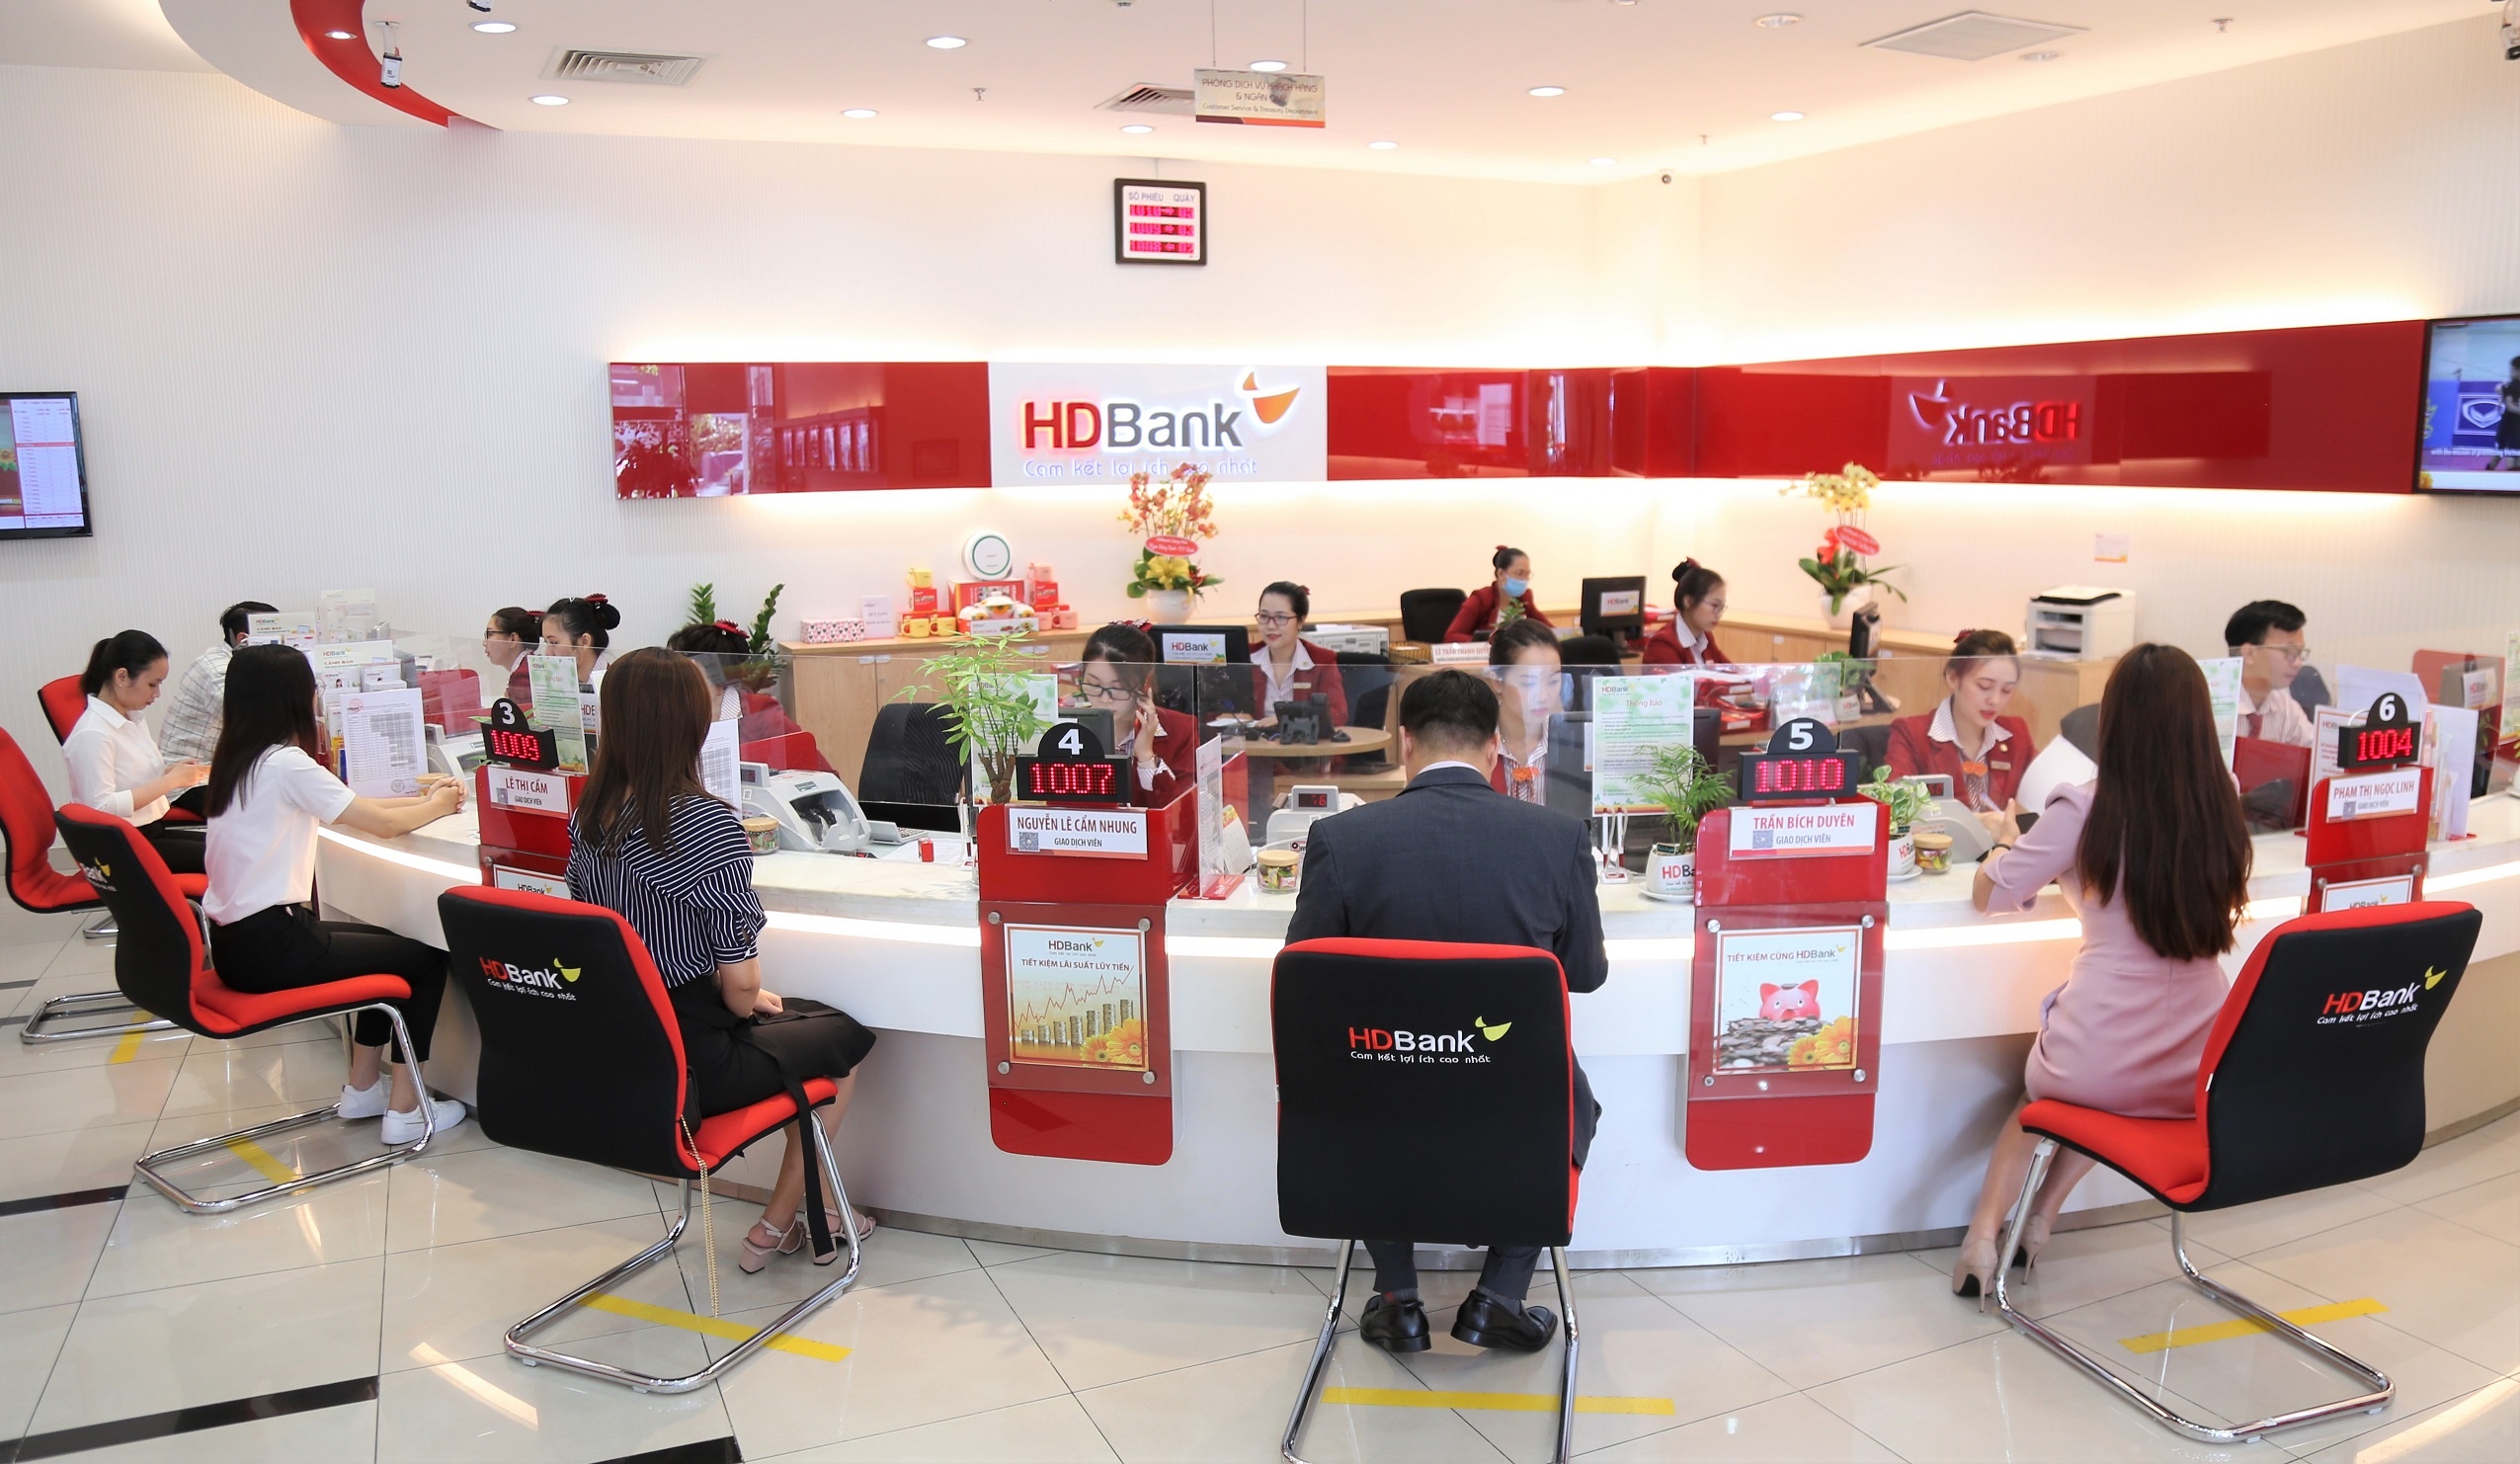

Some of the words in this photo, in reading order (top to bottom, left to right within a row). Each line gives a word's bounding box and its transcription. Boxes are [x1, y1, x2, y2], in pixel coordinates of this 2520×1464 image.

[1024, 401, 1243, 448] HDBank
[1172, 642, 1208, 651] HDBank
[499, 701, 516, 725] 3
[2379, 694, 2397, 722] 6
[491, 729, 540, 762] 1009
[1058, 728, 1083, 755] 4
[1789, 722, 1814, 750] 5
[2357, 727, 2413, 762] 1004
[505, 776, 515, 789] LÊ
[517, 778, 529, 794] THỊ
[1030, 763, 1113, 794] 1007
[1755, 758, 1843, 793] 1010
[2333, 785, 2358, 802] PHẠM
[2359, 784, 2373, 799] THỊ
[2374, 783, 2396, 798] NGỌC
[2397, 780, 2415, 792] LINH
[1016, 813, 1057, 832] NGUYỄN
[1061, 816, 1072, 832] LÊ
[1099, 819, 1137, 835] NHUNG
[1787, 812, 1814, 829] BÍCH
[1817, 812, 1855, 828] DUYÊN
[1054, 837, 1070, 847] GIAO
[1071, 838, 1086, 849] DỊCH
[1087, 838, 1102, 848] VIÊN
[1776, 836, 1794, 845] GIAO
[1795, 836, 1813, 847] DỊCH
[1814, 834, 1831, 844] VIÊN
[1048, 939, 1093, 952] HDBank
[1727, 951, 1746, 962] TIẾT
[1747, 951, 1768, 963] KIỆM
[1770, 950, 1795, 960] CÙNG
[1796, 948, 1836, 959] HDBank
[478, 956, 562, 990] HDBank
[1039, 959, 1058, 968] KIỆM
[1074, 960, 1094, 970] SUẤT
[1096, 961, 1110, 971] LŨY
[1112, 962, 1129, 972] TIẾN
[487, 978, 502, 988] Cam
[2322, 982, 2421, 1015] HDBank
[2317, 1016, 2336, 1024] Cam
[2338, 1014, 2355, 1023] kết
[2400, 1003, 2419, 1015] nhất
[1348, 1026, 1476, 1053] HDBank
[1350, 1050, 1373, 1060] Cam
[1377, 1052, 1396, 1062] kết
[1400, 1054, 1415, 1064] lợi
[1419, 1055, 1435, 1064] ích
[1465, 1054, 1492, 1064] nhất
